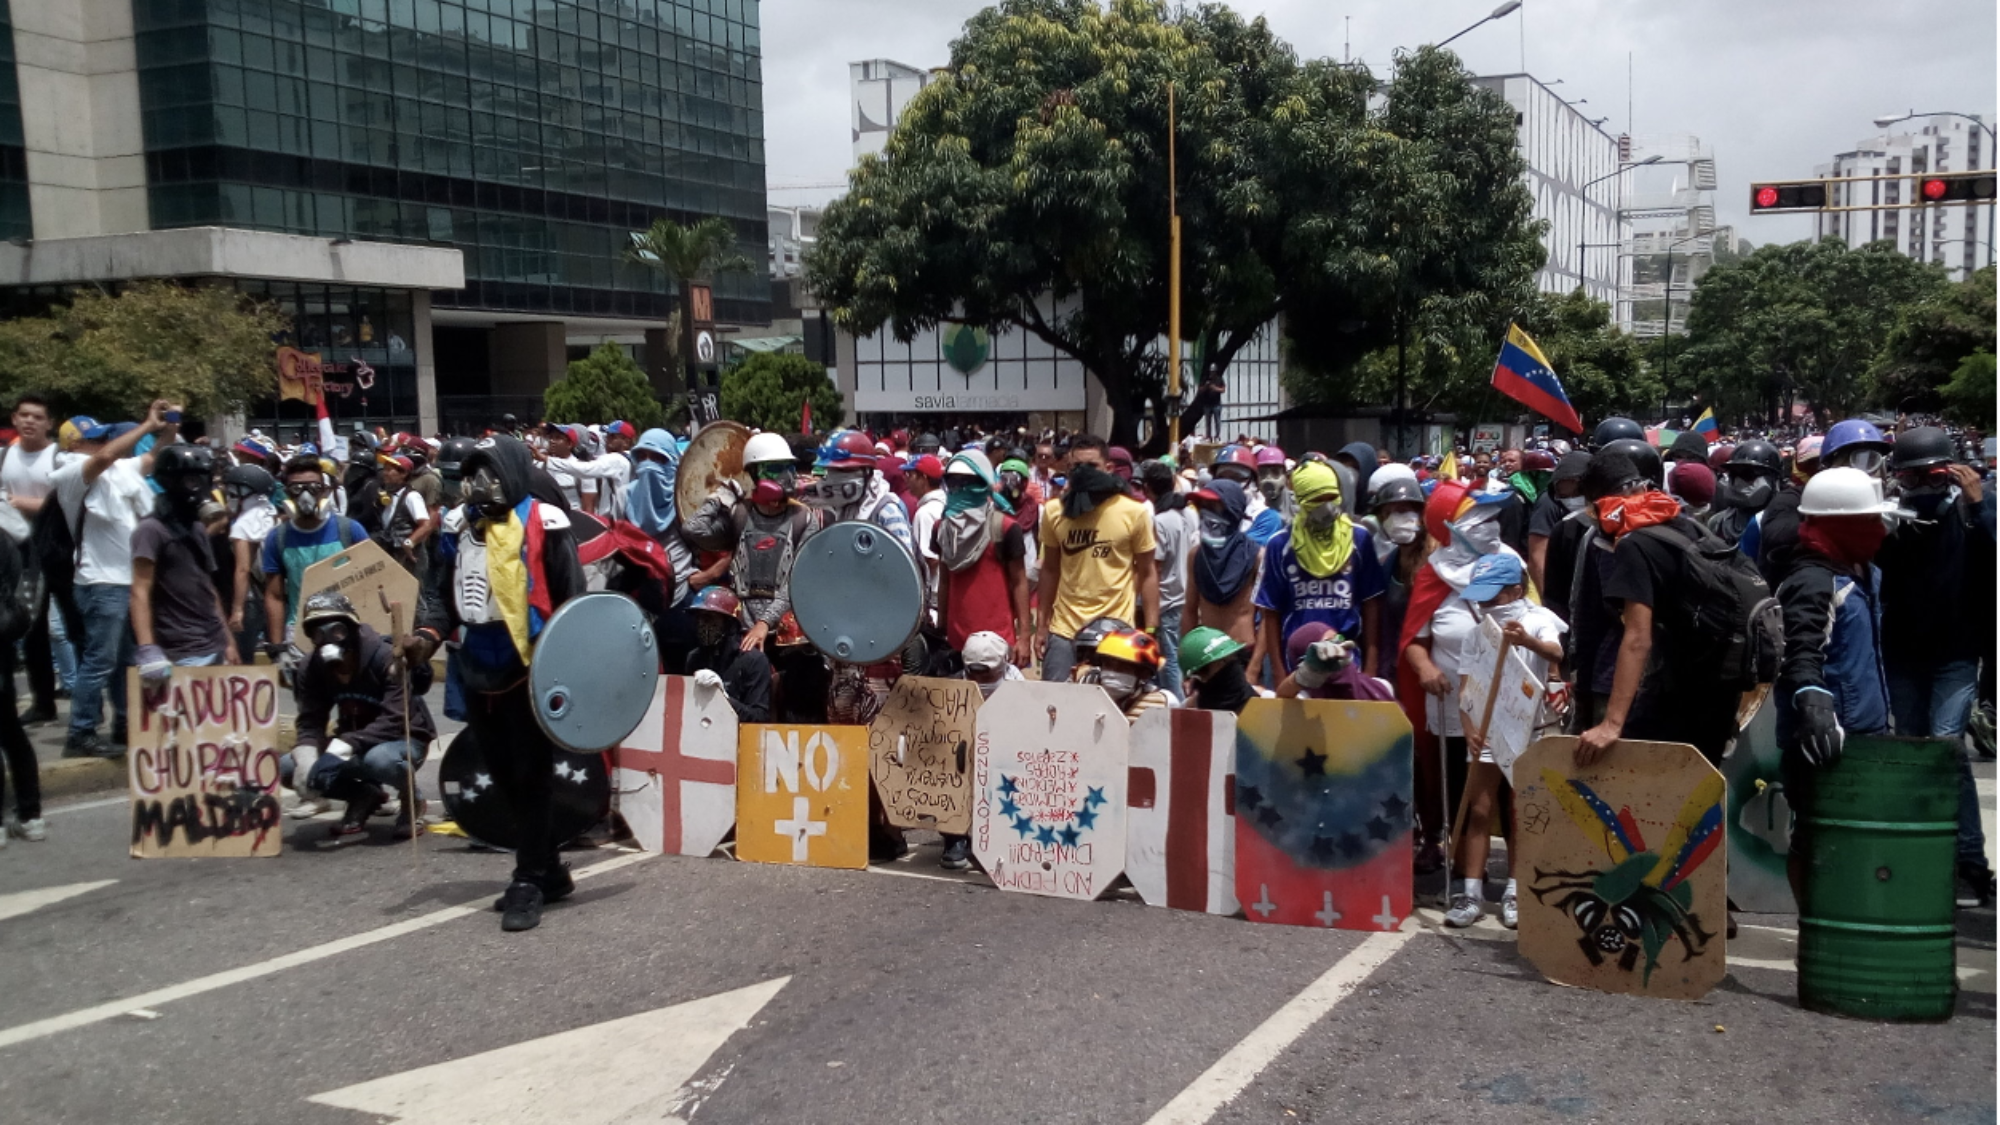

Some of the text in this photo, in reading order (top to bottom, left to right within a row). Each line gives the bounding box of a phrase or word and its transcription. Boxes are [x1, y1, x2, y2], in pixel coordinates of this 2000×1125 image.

[692, 287, 712, 321] M
[1067, 530, 1099, 544] NIKE
[1092, 546, 1111, 558] SB
[1295, 598, 1351, 610] SIEMENS
[140, 677, 276, 734] MADURO
[764, 730, 839, 793] NO
[1063, 870, 1093, 896] NO
